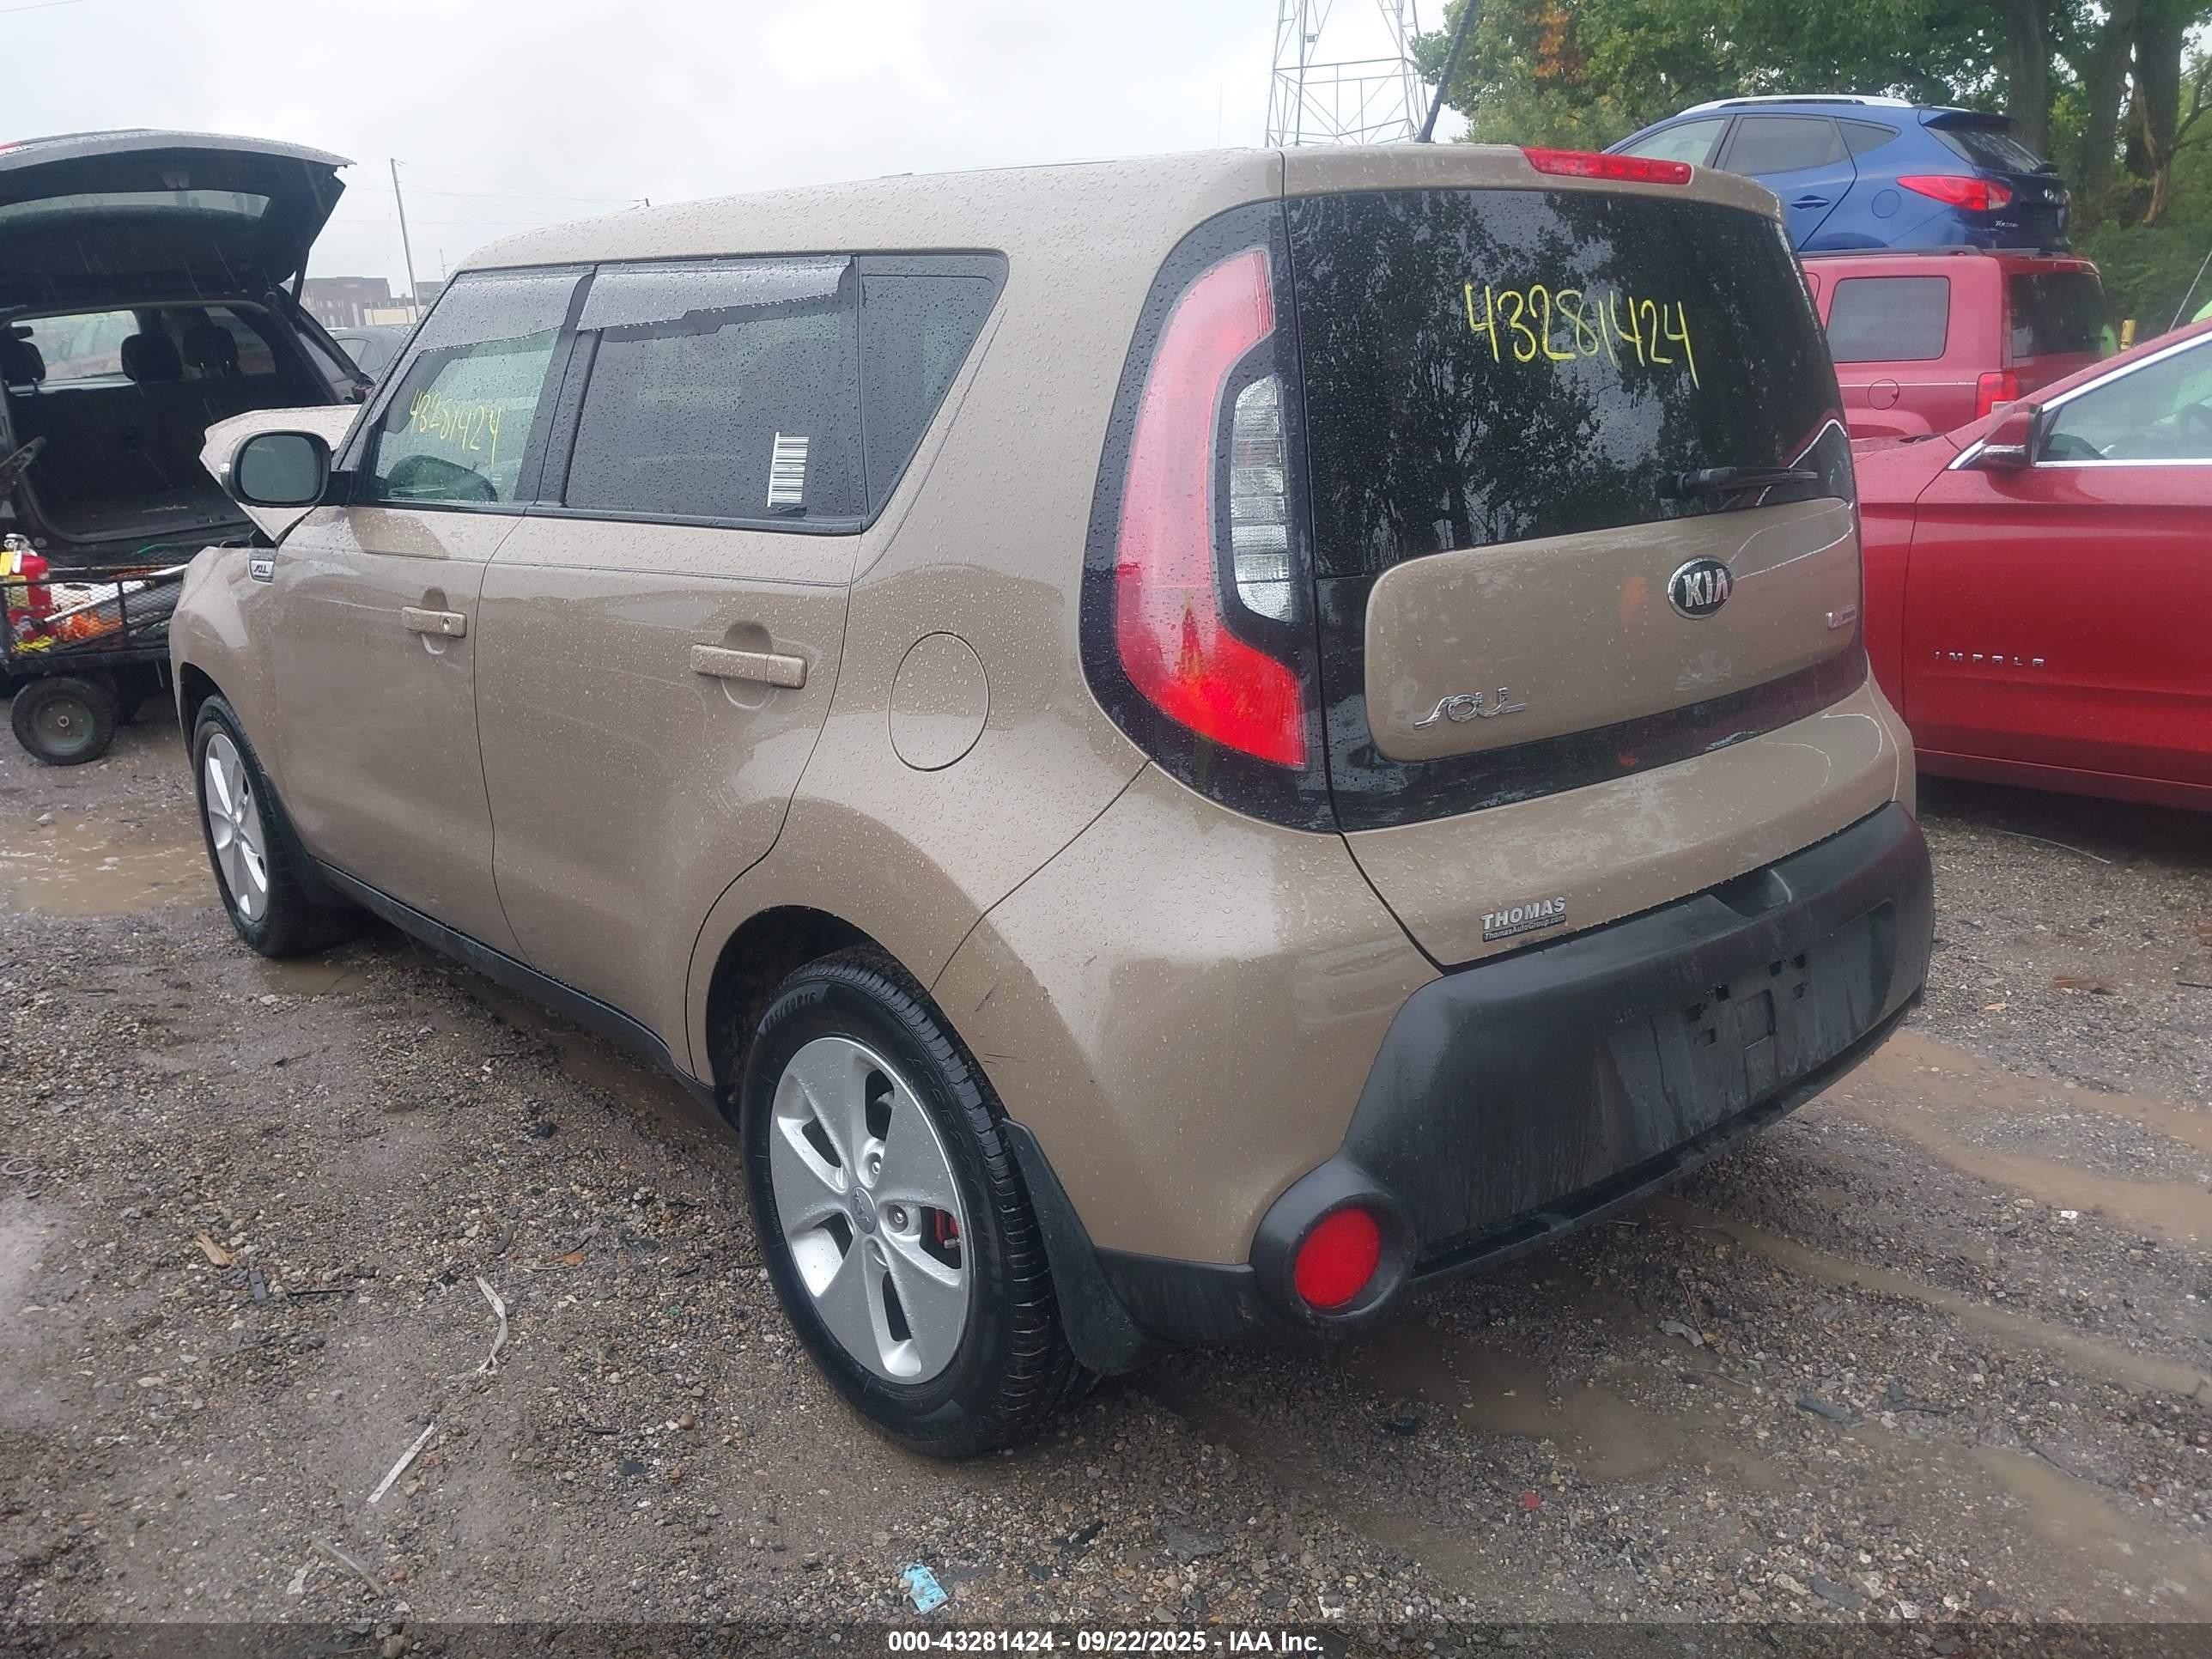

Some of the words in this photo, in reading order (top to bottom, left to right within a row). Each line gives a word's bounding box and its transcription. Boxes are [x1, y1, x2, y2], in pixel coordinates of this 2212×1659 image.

[1464, 282, 1699, 389] 43281424
[1681, 567, 1729, 608] KIA
[1934, 650, 2045, 667] IMPALA
[1480, 896, 1565, 931] THOMAS
